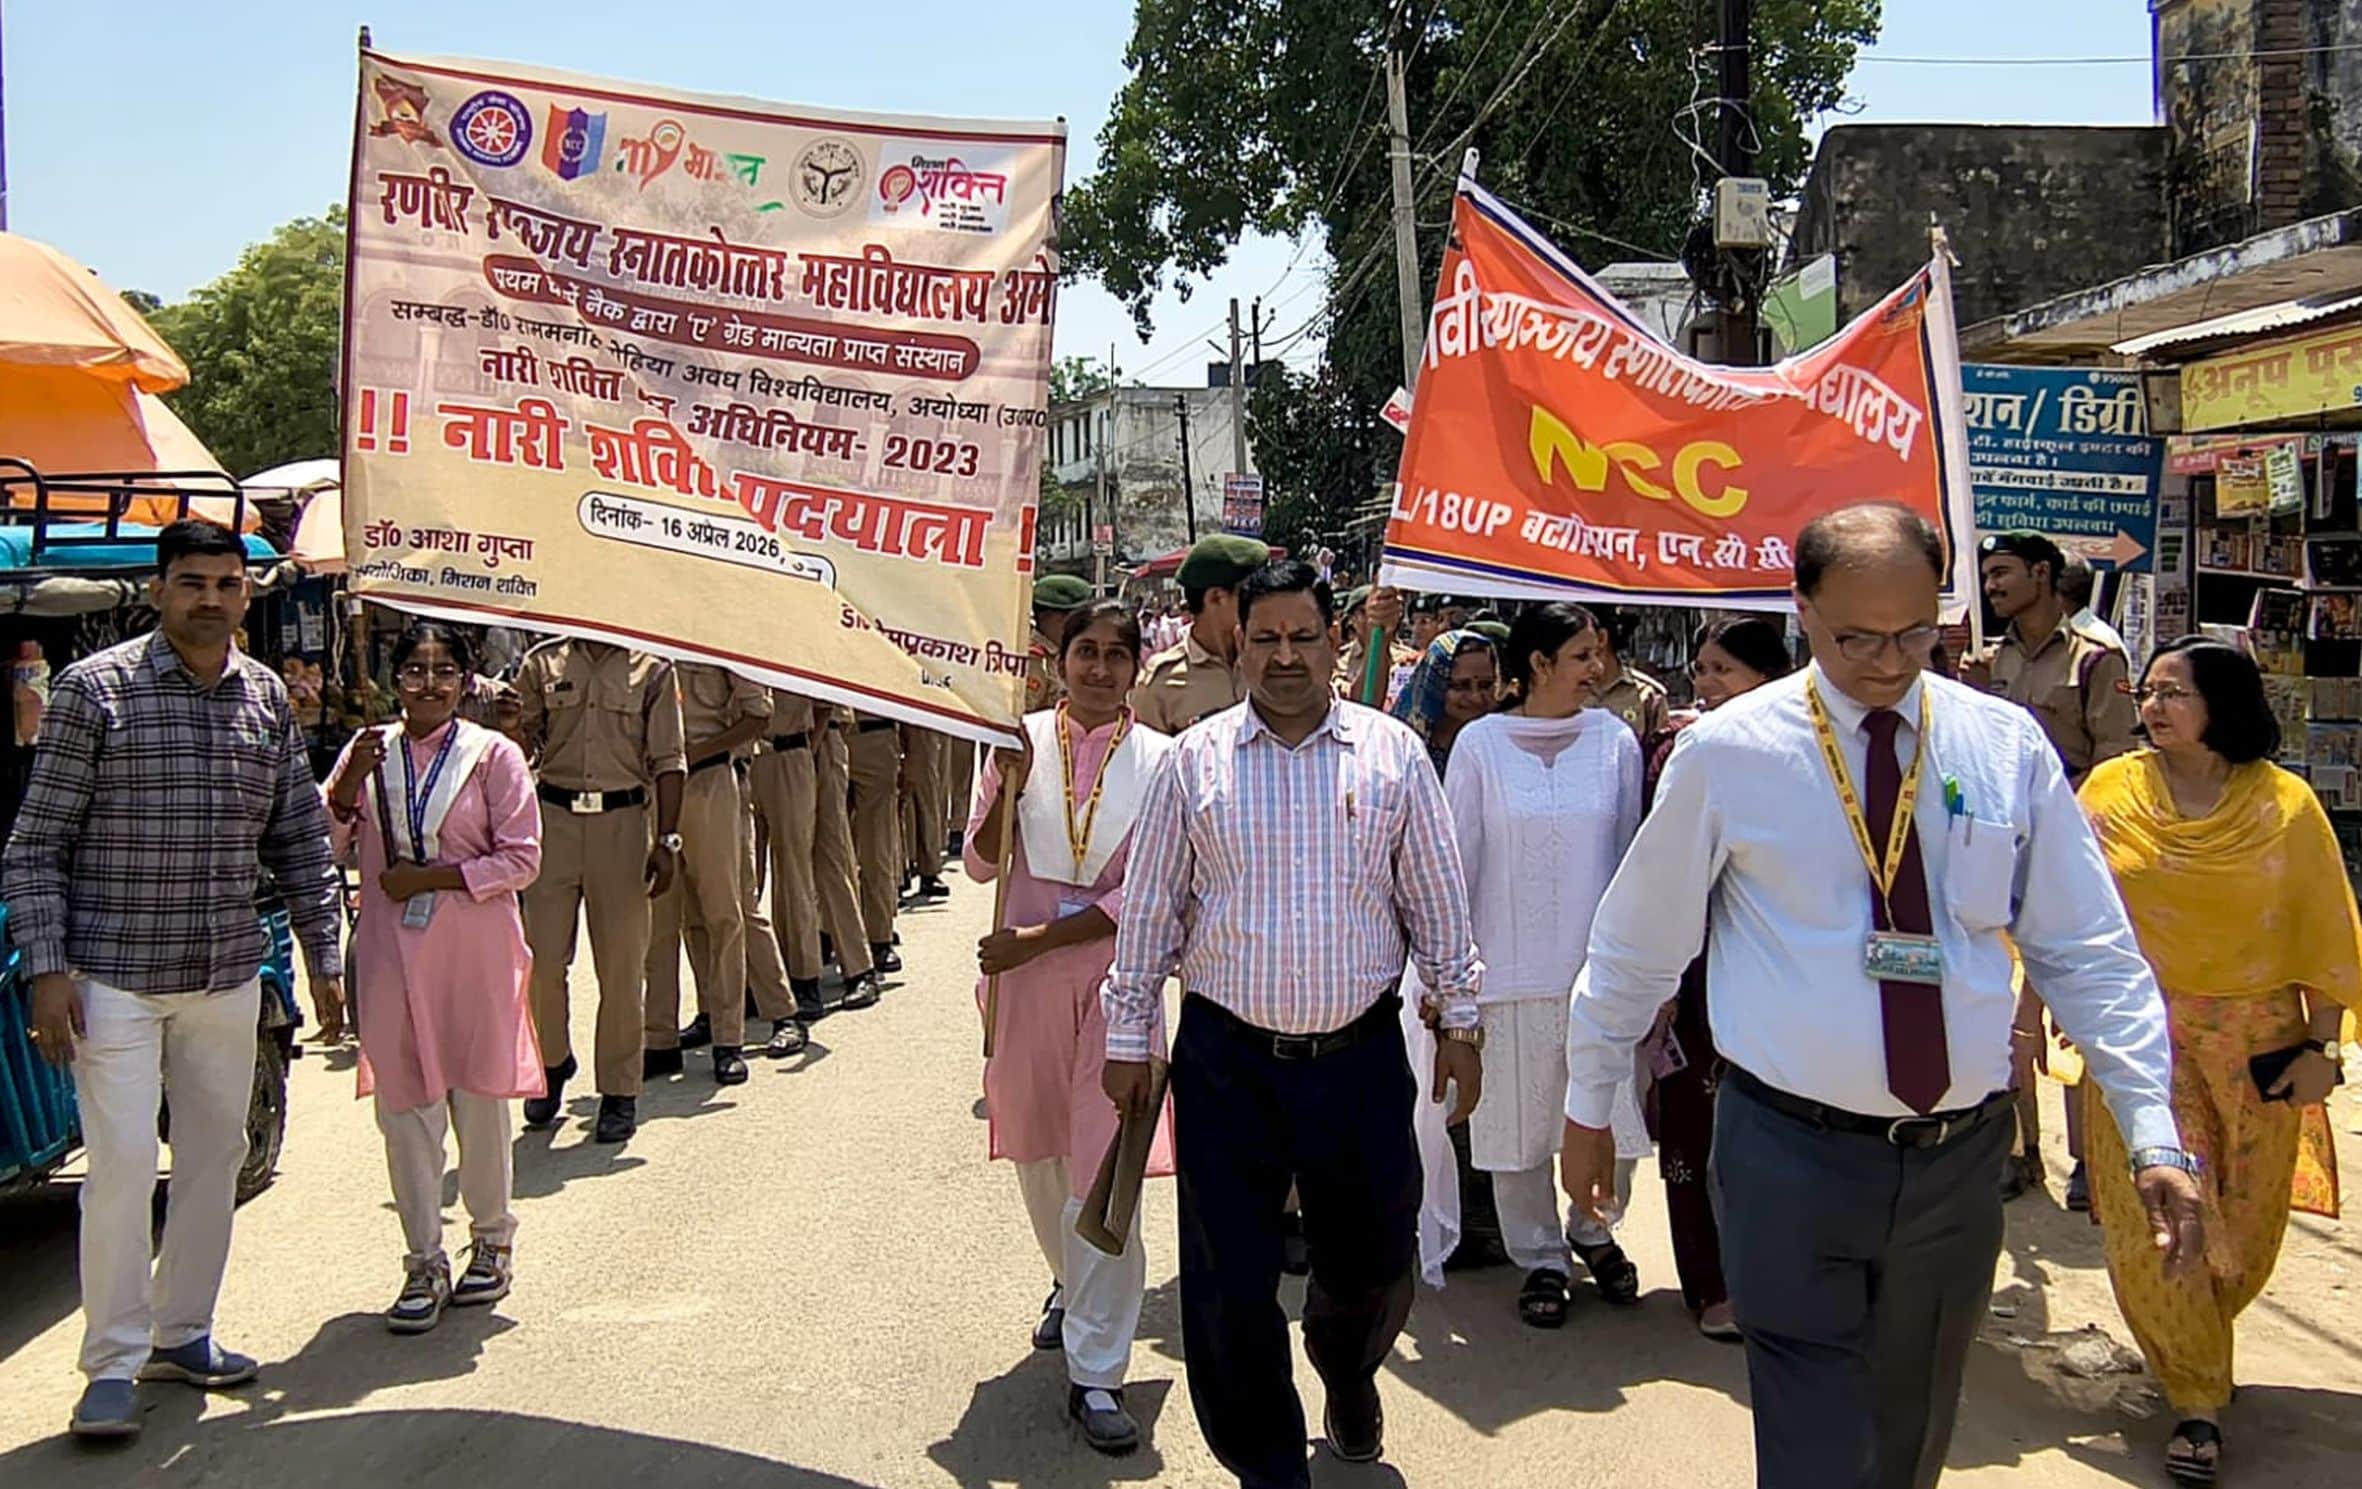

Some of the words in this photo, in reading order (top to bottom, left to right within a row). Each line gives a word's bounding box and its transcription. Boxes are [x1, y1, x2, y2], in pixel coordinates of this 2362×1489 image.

[684, 142, 766, 186] भात
[917, 157, 1008, 216] शक्ति
[798, 244, 995, 323] महाविद्यालय
[585, 288, 627, 321] नैक
[630, 306, 679, 335] द्वारा
[723, 314, 756, 348] ग्रेड
[762, 326, 836, 359] मान्यता
[843, 337, 888, 366] प्राप्त
[896, 338, 966, 374] संस्थान
[515, 317, 602, 347] राममनोह
[609, 339, 676, 378] ोहिया
[682, 364, 742, 392] अवध
[909, 392, 991, 424] अयोध्या
[438, 398, 568, 471] नारी
[480, 346, 539, 385] नारी
[547, 356, 625, 402] शक्ति
[884, 435, 980, 478] 2023
[2057, 385, 2145, 436] डिग्री
[409, 529, 471, 553] आशा
[477, 533, 536, 568] गुप्ता
[661, 517, 683, 538] 16
[441, 566, 492, 591] मिशन
